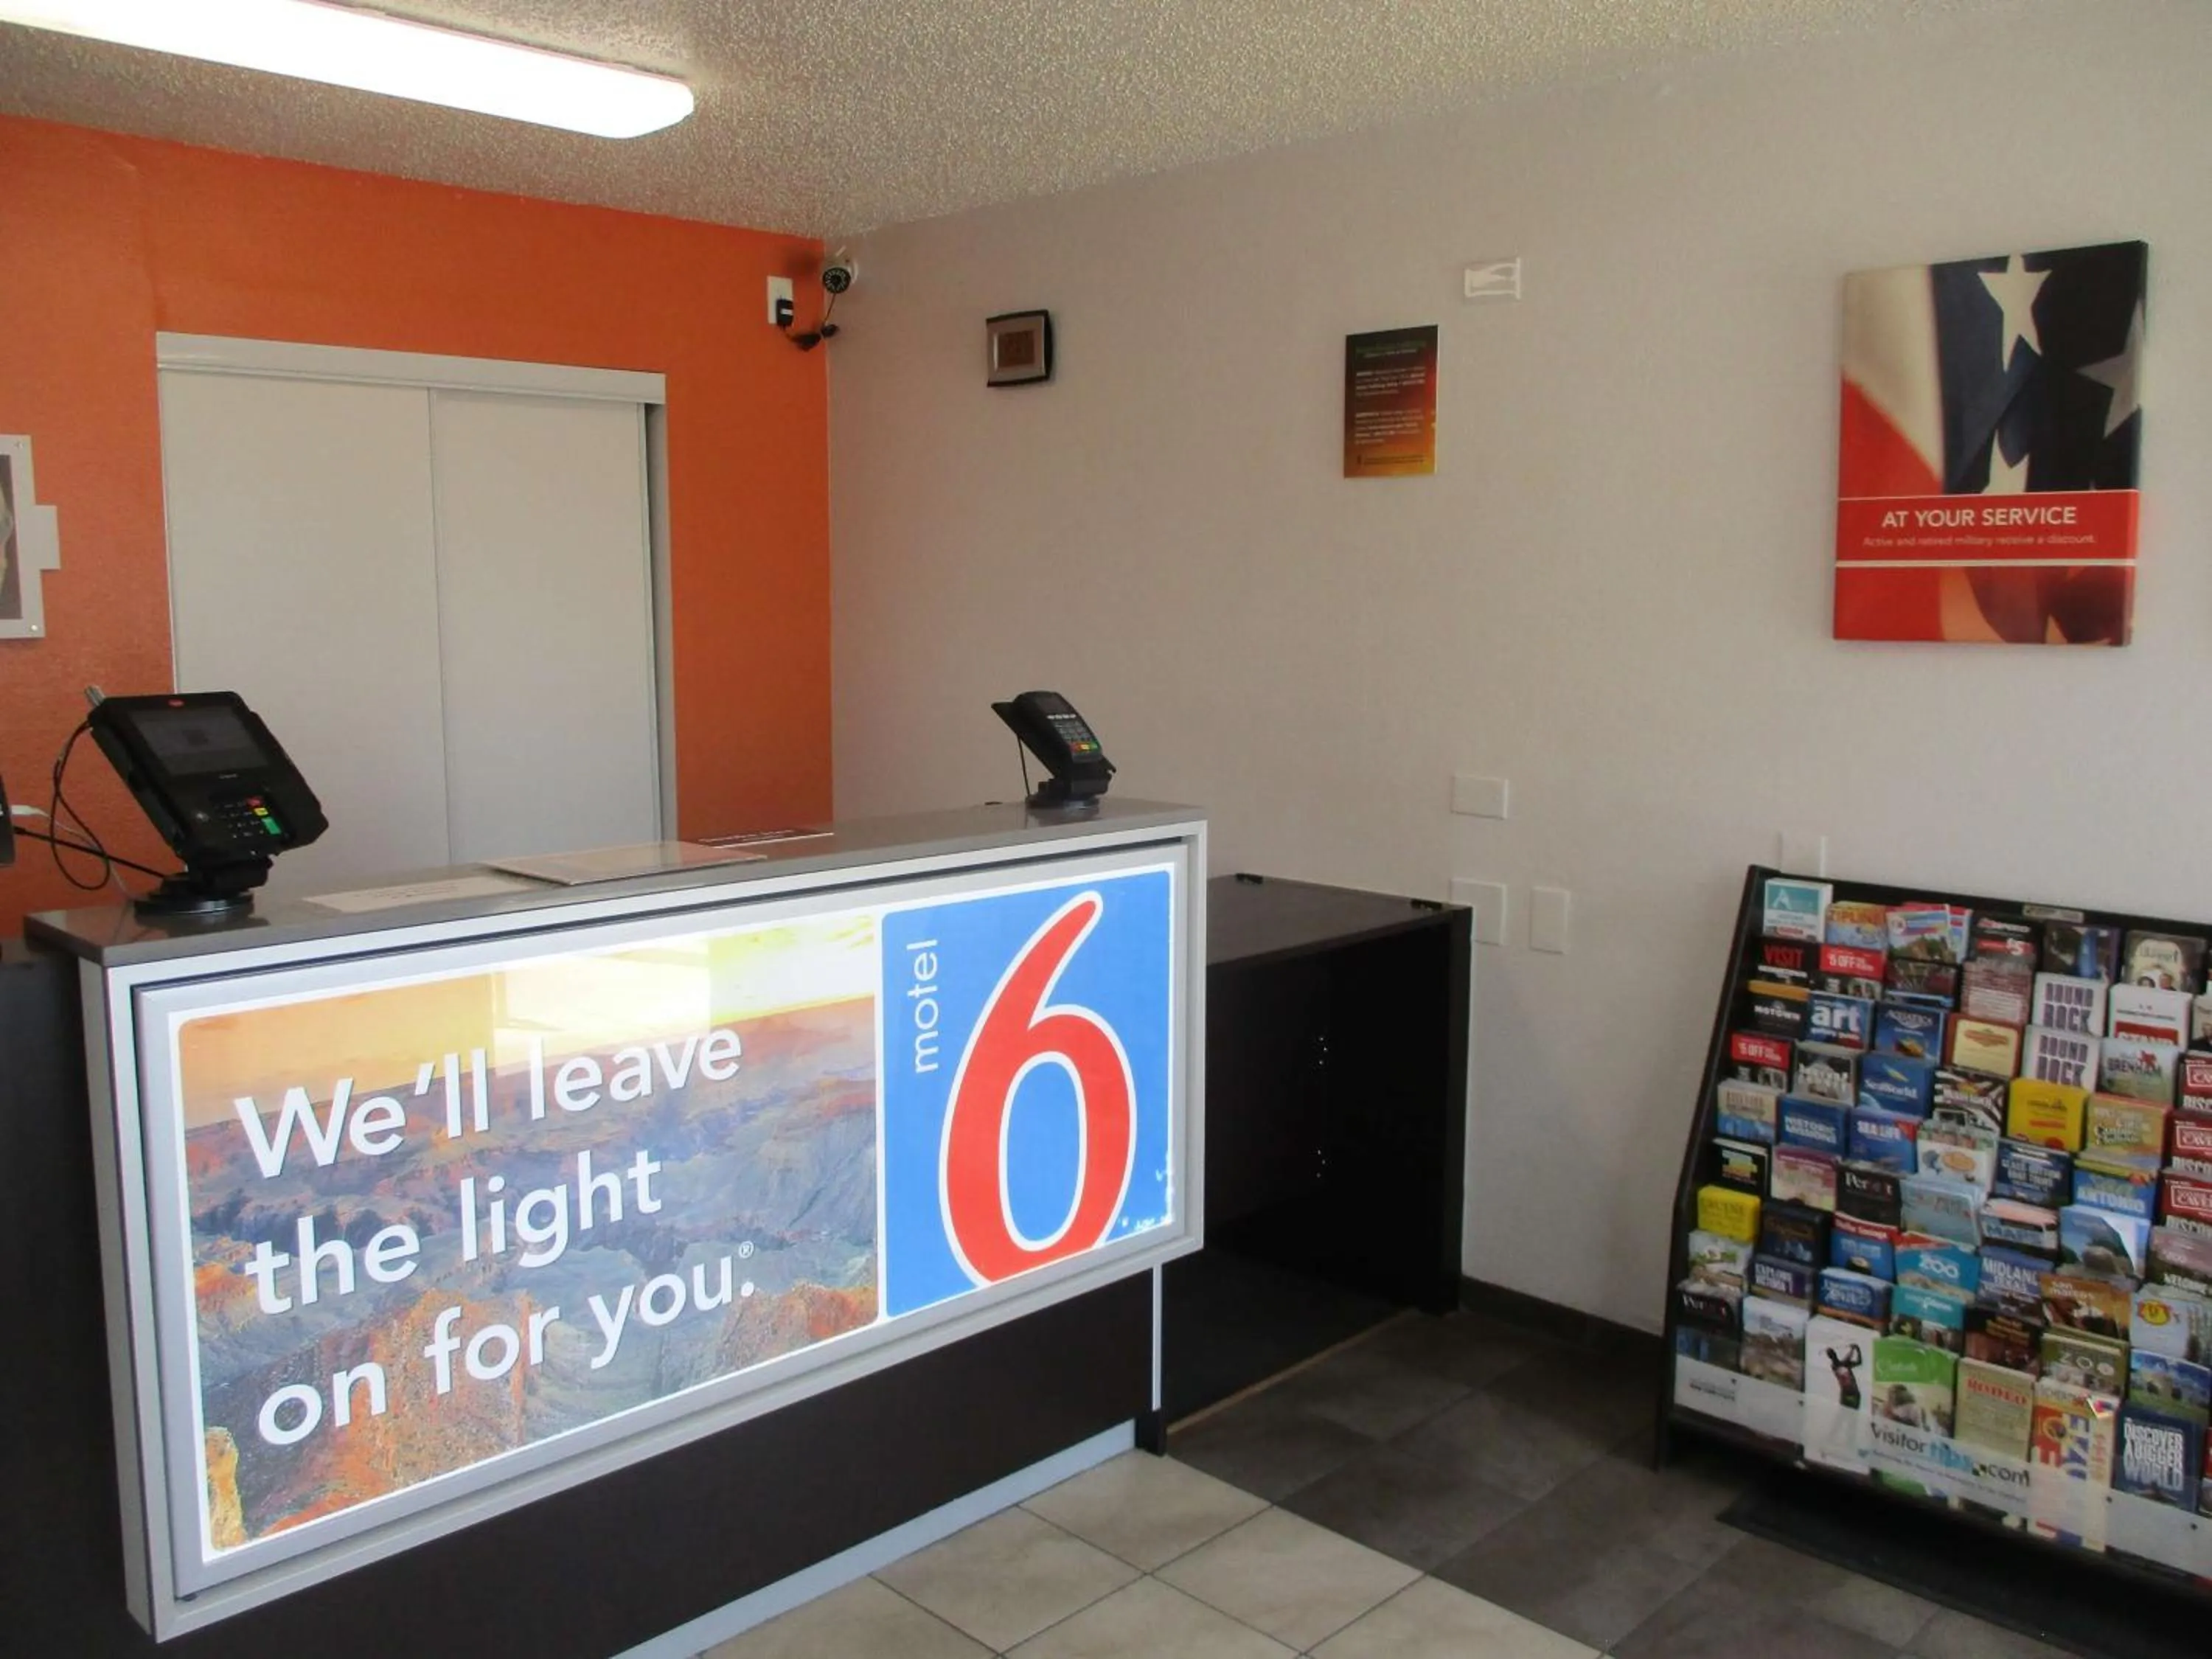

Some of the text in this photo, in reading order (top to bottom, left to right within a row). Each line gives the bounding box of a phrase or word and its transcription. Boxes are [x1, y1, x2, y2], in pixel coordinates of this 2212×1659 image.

[1882, 506, 2077, 528] AT YOUR SERVICE
[1863, 537, 1893, 547] Active
[1897, 536, 1916, 546] and
[1918, 536, 1952, 546] retired
[1955, 535, 1991, 548] military
[1994, 535, 2034, 546] receive
[2037, 537, 2044, 545] a
[2045, 981, 2094, 1008] ROUND
[1811, 1004, 1860, 1034] art
[2042, 1003, 2091, 1034] ROCK
[2039, 1034, 2089, 1063] ROUND
[2037, 1055, 2086, 1088] ROCK
[234, 1029, 742, 1178] We'll leave
[905, 890, 1137, 1287] motel 6
[245, 1150, 662, 1315] the light
[258, 1361, 387, 1445] on
[424, 1307, 560, 1395] for
[2124, 1422, 2183, 1451] DISCOVER
